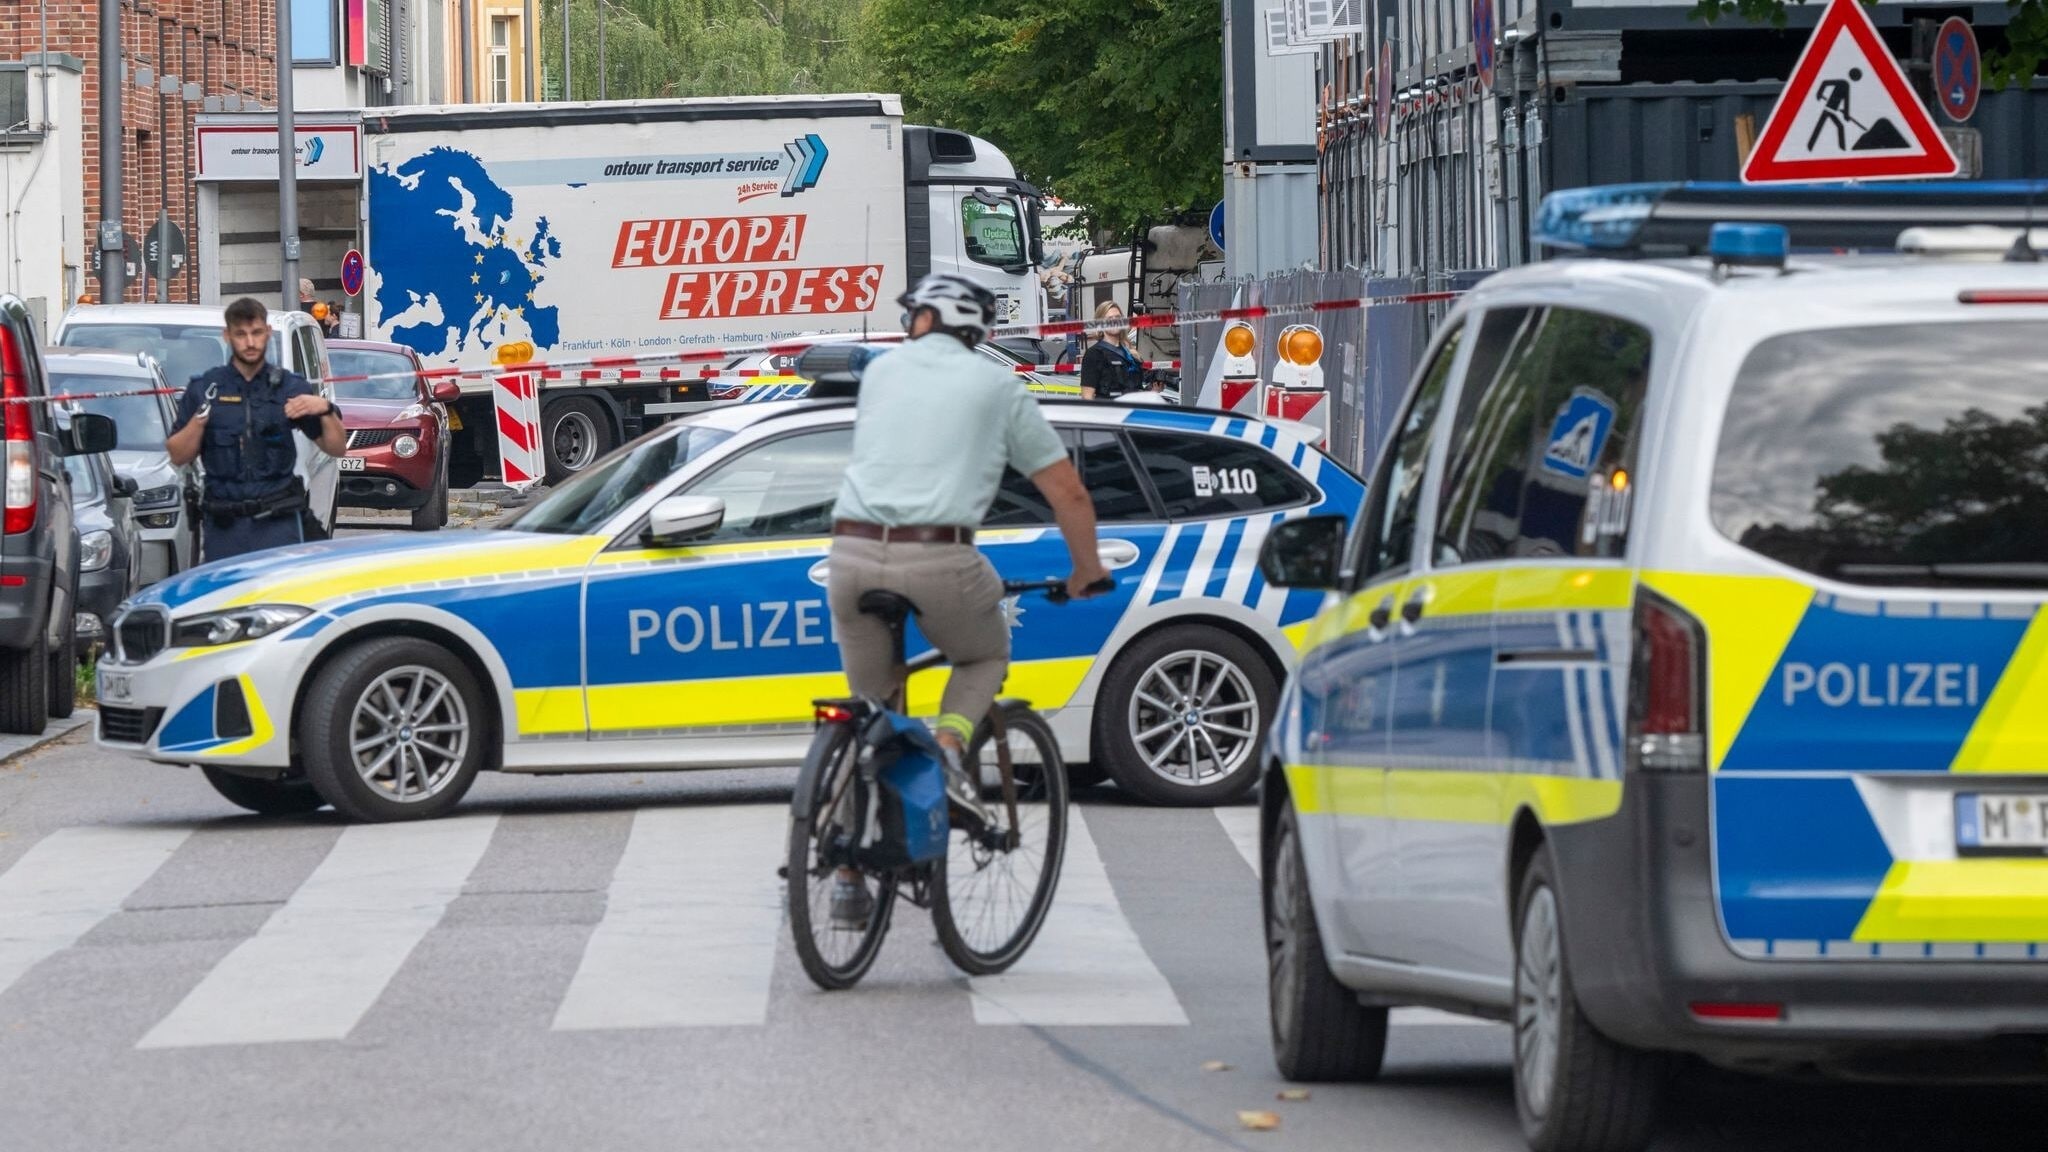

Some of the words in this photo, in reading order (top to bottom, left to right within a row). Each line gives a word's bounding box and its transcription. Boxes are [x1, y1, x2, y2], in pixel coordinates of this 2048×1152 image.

[231, 147, 250, 155] ontour
[252, 147, 280, 156] transpor
[604, 159, 652, 176] ontour
[656, 157, 724, 176] transport
[726, 156, 780, 172] service
[737, 184, 752, 196] 24h
[751, 181, 778, 193] Service
[618, 216, 797, 267] EUROPA
[662, 267, 879, 317] EXPRESS
[562, 339, 603, 350] Frankfurt
[611, 337, 631, 348] Köln
[638, 335, 671, 346] London
[679, 333, 715, 345] Grefrath
[723, 331, 763, 342] Hamburg
[341, 459, 362, 470] GYZ
[1218, 468, 1257, 494] 110
[1783, 662, 1979, 707] POLIZEI
